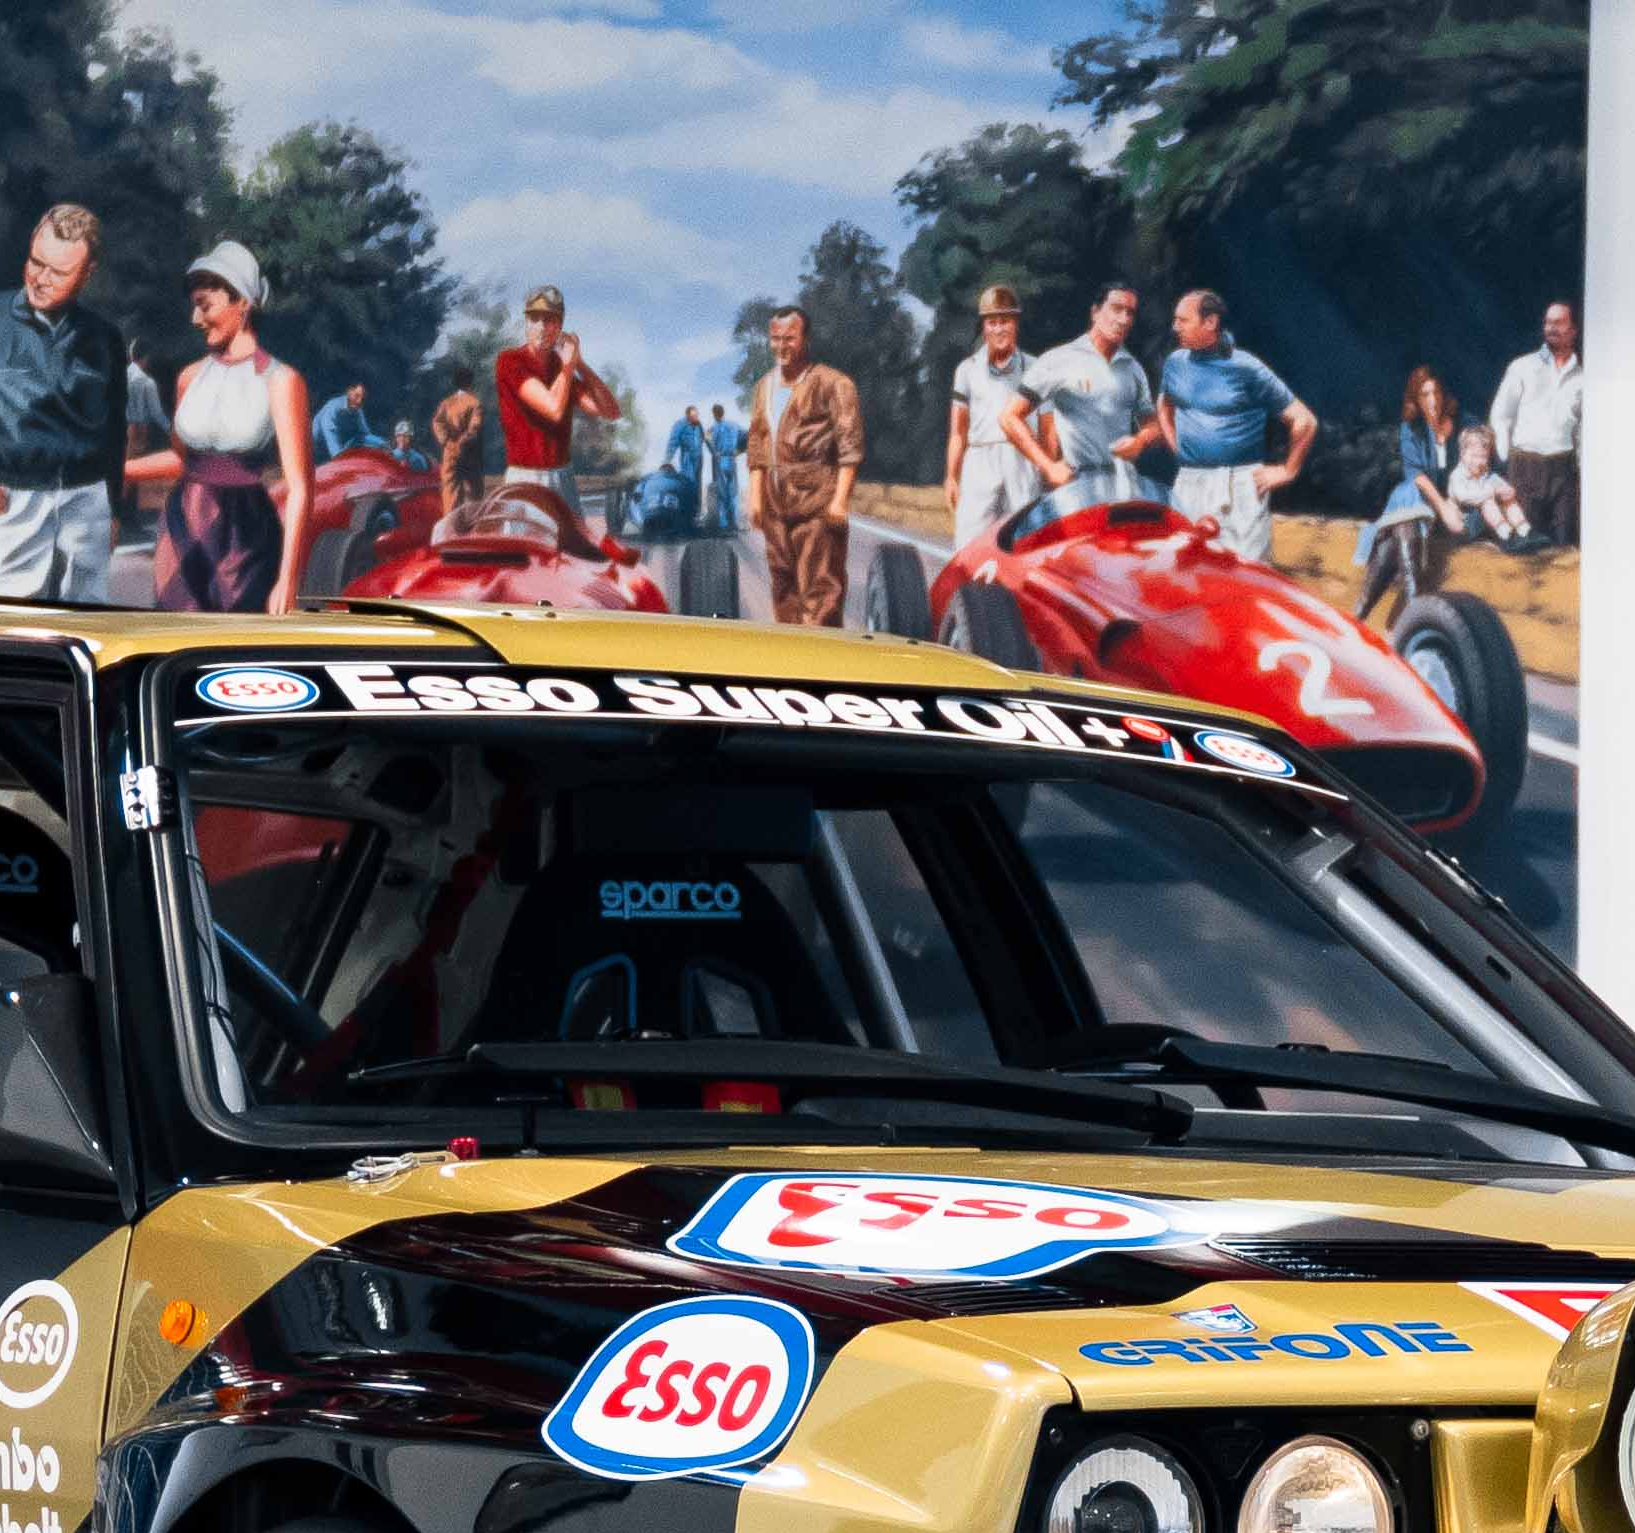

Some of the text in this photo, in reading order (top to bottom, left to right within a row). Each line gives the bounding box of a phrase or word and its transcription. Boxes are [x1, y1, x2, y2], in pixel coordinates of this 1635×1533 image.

[216, 681, 300, 698] Esso
[325, 664, 600, 712] Esso
[614, 674, 926, 728] Super
[1259, 640, 1375, 716] 2
[600, 880, 741, 918] sparco
[767, 1182, 1130, 1248] Esso
[1, 1311, 64, 1365] Esso
[602, 1340, 771, 1431] Esso
